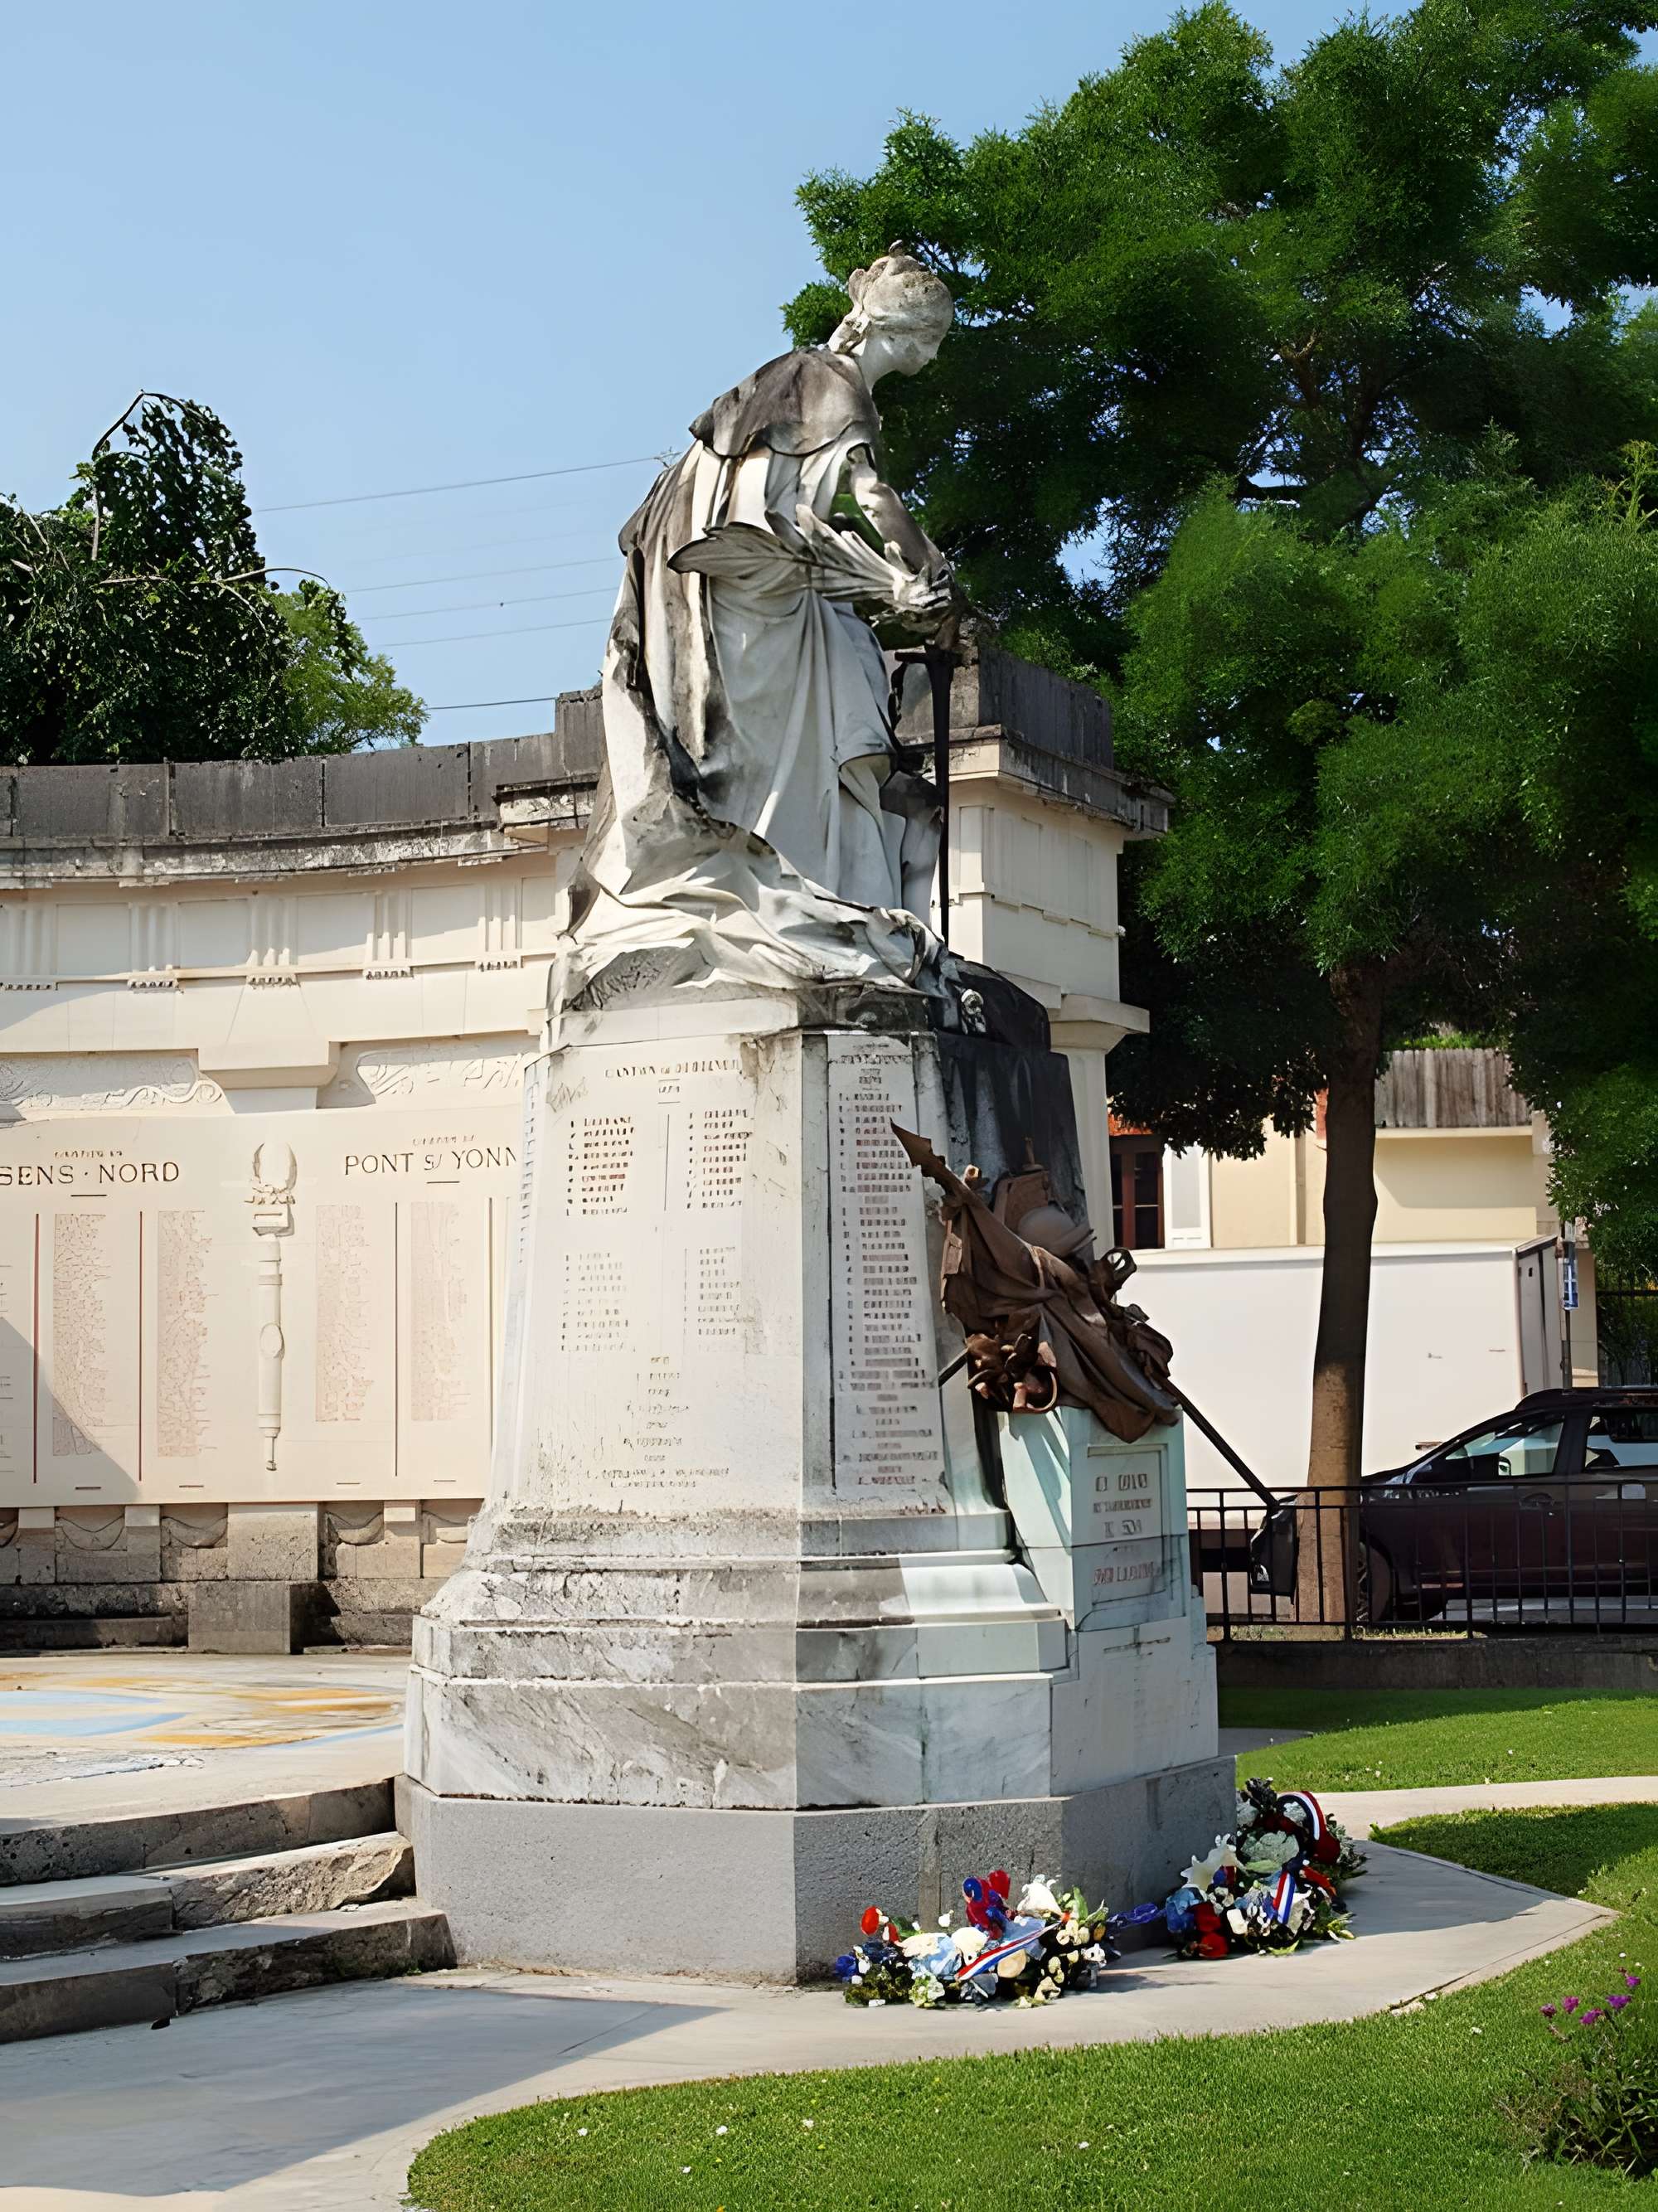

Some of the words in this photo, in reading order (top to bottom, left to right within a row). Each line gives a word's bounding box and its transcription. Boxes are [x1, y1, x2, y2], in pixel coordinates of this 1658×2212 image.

[0, 1165, 74, 1186] SENS
[99, 1162, 180, 1184] NORD
[345, 1152, 414, 1175] PONT
